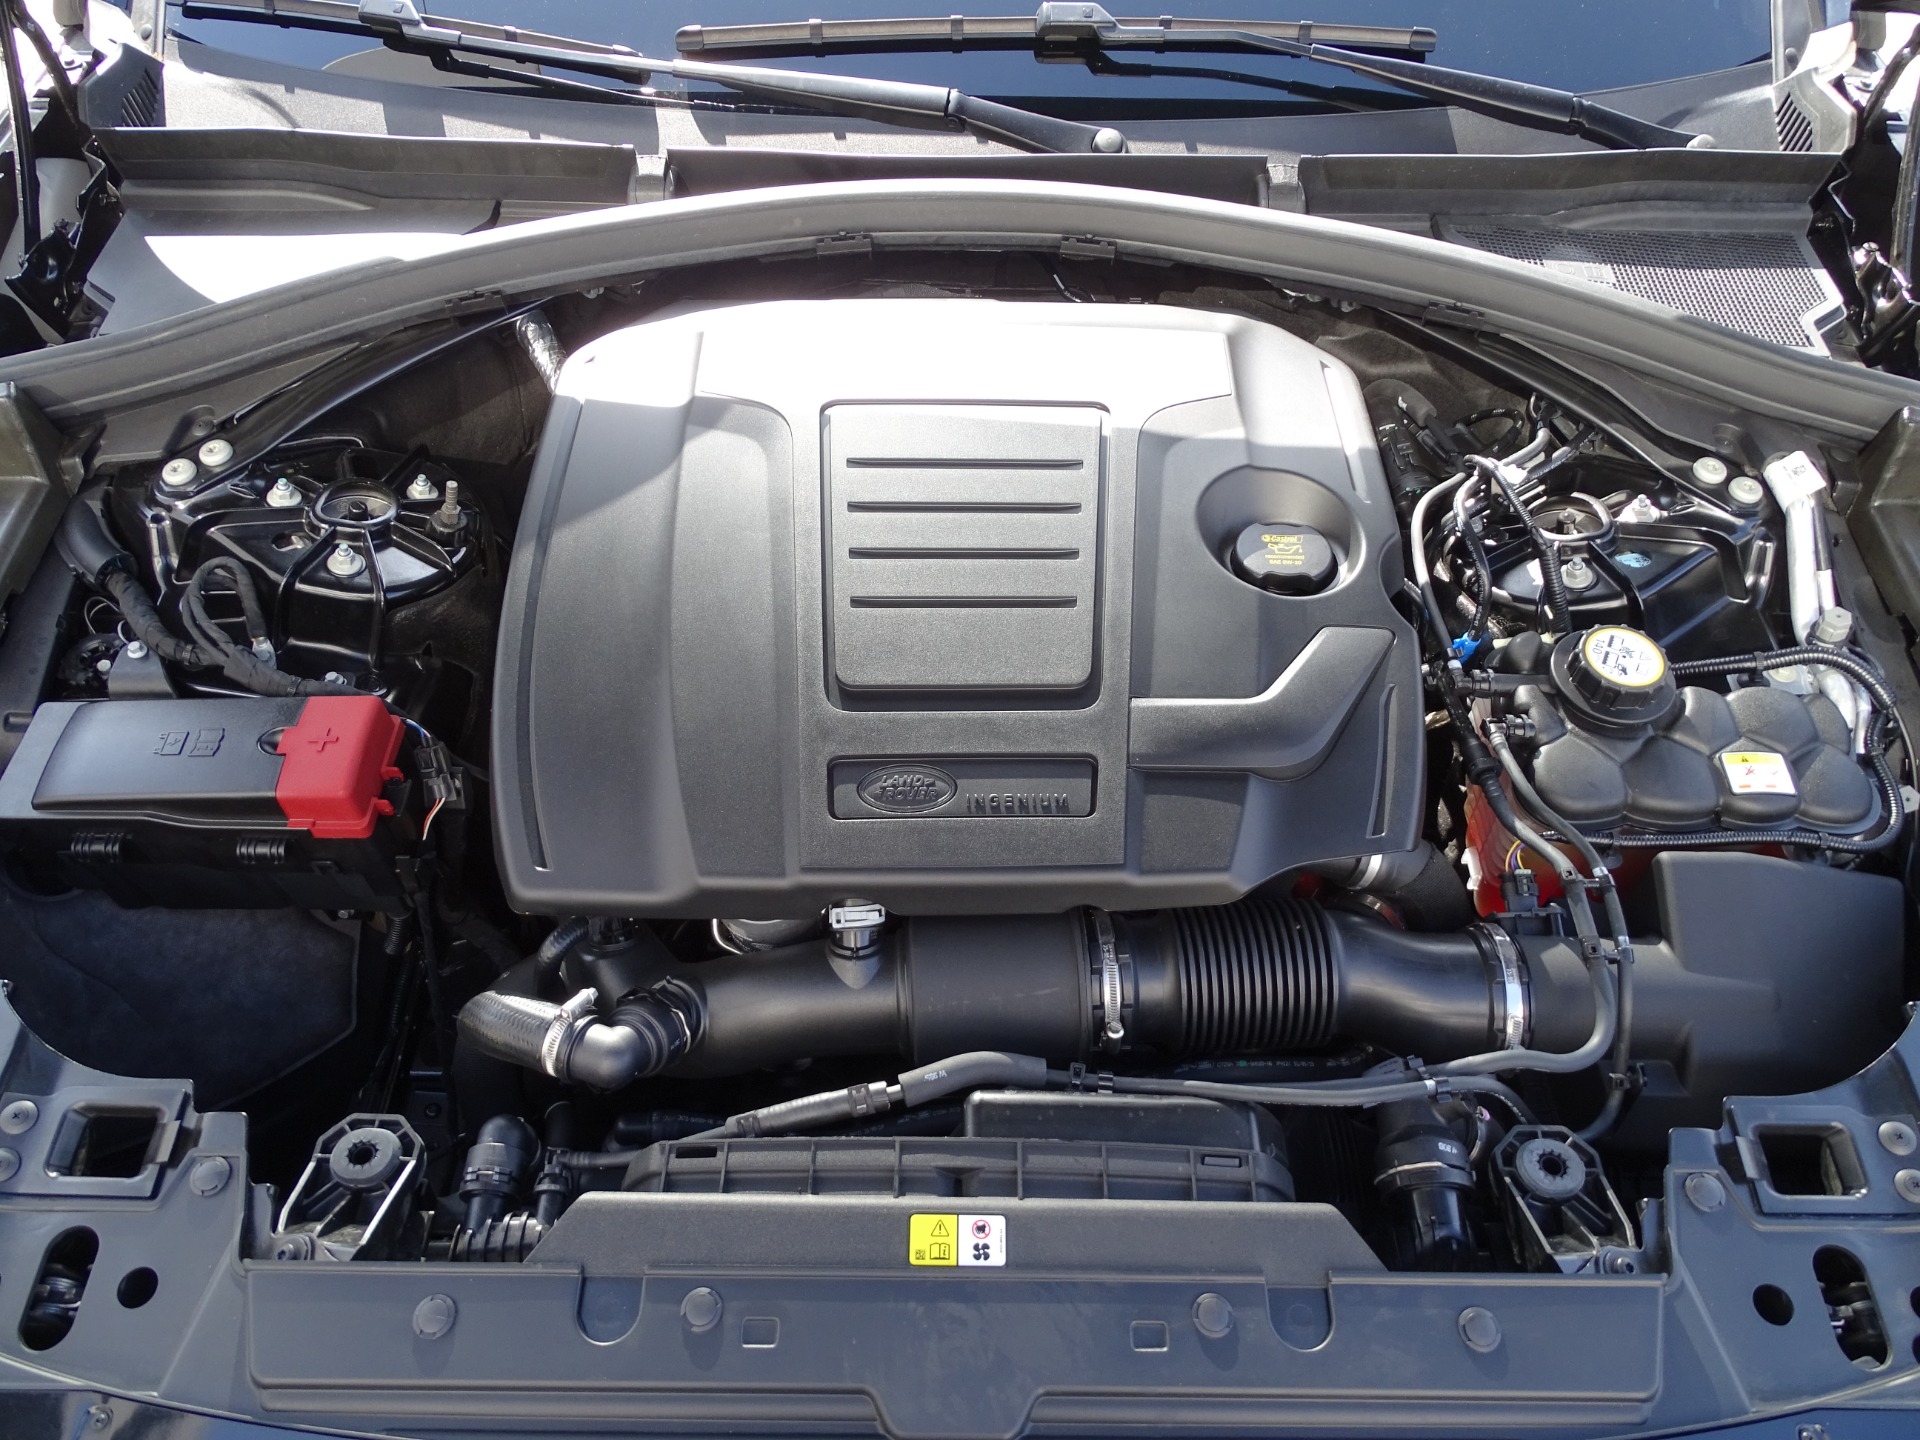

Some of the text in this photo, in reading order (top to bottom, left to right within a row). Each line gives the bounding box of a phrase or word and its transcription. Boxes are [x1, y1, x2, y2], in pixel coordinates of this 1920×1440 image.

[1270, 535, 1298, 543] Castrol
[881, 774, 924, 787] LAND
[882, 787, 937, 800] ROVER
[966, 793, 1069, 810] INGENIUM
